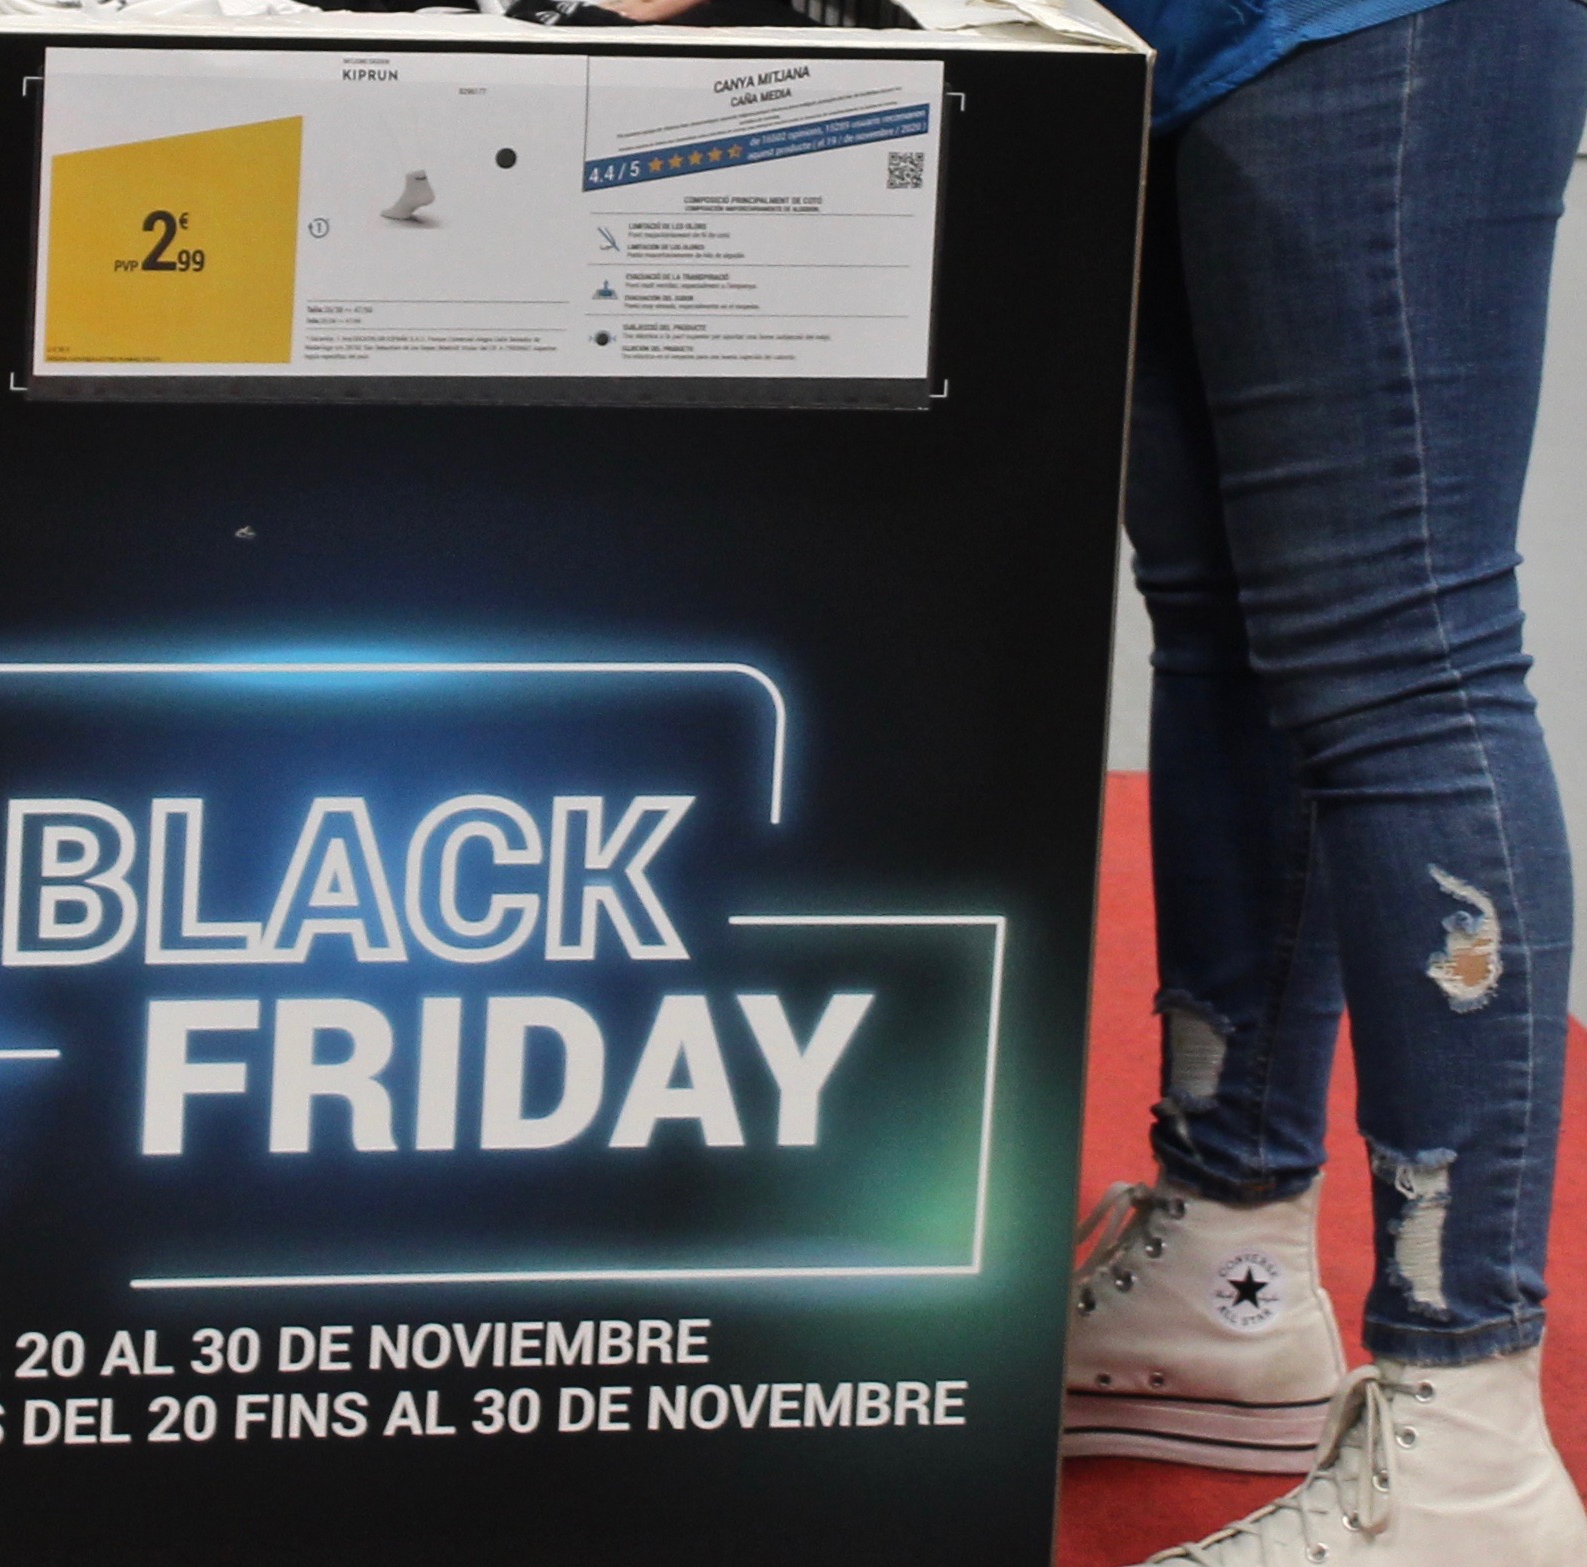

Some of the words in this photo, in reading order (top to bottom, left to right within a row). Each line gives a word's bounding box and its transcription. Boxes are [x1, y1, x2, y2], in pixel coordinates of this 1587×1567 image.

[342, 69, 398, 81] KIPRUN
[713, 77, 755, 94] CANYA
[757, 65, 810, 87] MITJANA
[730, 93, 760, 108] CAÑA
[760, 87, 792, 104] MEDIA
[589, 165, 615, 183] 4.4
[630, 161, 640, 177] 5
[114, 260, 139, 271] PVP
[1, 793, 696, 967] BLACK
[140, 992, 876, 1157] FRIDAY
[14, 1330, 86, 1378] 20
[100, 1329, 175, 1377] AL
[189, 1327, 261, 1375] 30
[277, 1325, 353, 1373] DE
[368, 1318, 711, 1371] NOVIEMBRE
[22, 1397, 132, 1446] DEL
[146, 1394, 218, 1443] 20
[234, 1391, 369, 1440] FINS
[382, 1389, 457, 1437] AL
[471, 1386, 542, 1435] 30
[557, 1385, 633, 1433] DE
[647, 1380, 969, 1431] NOVEMBRE
